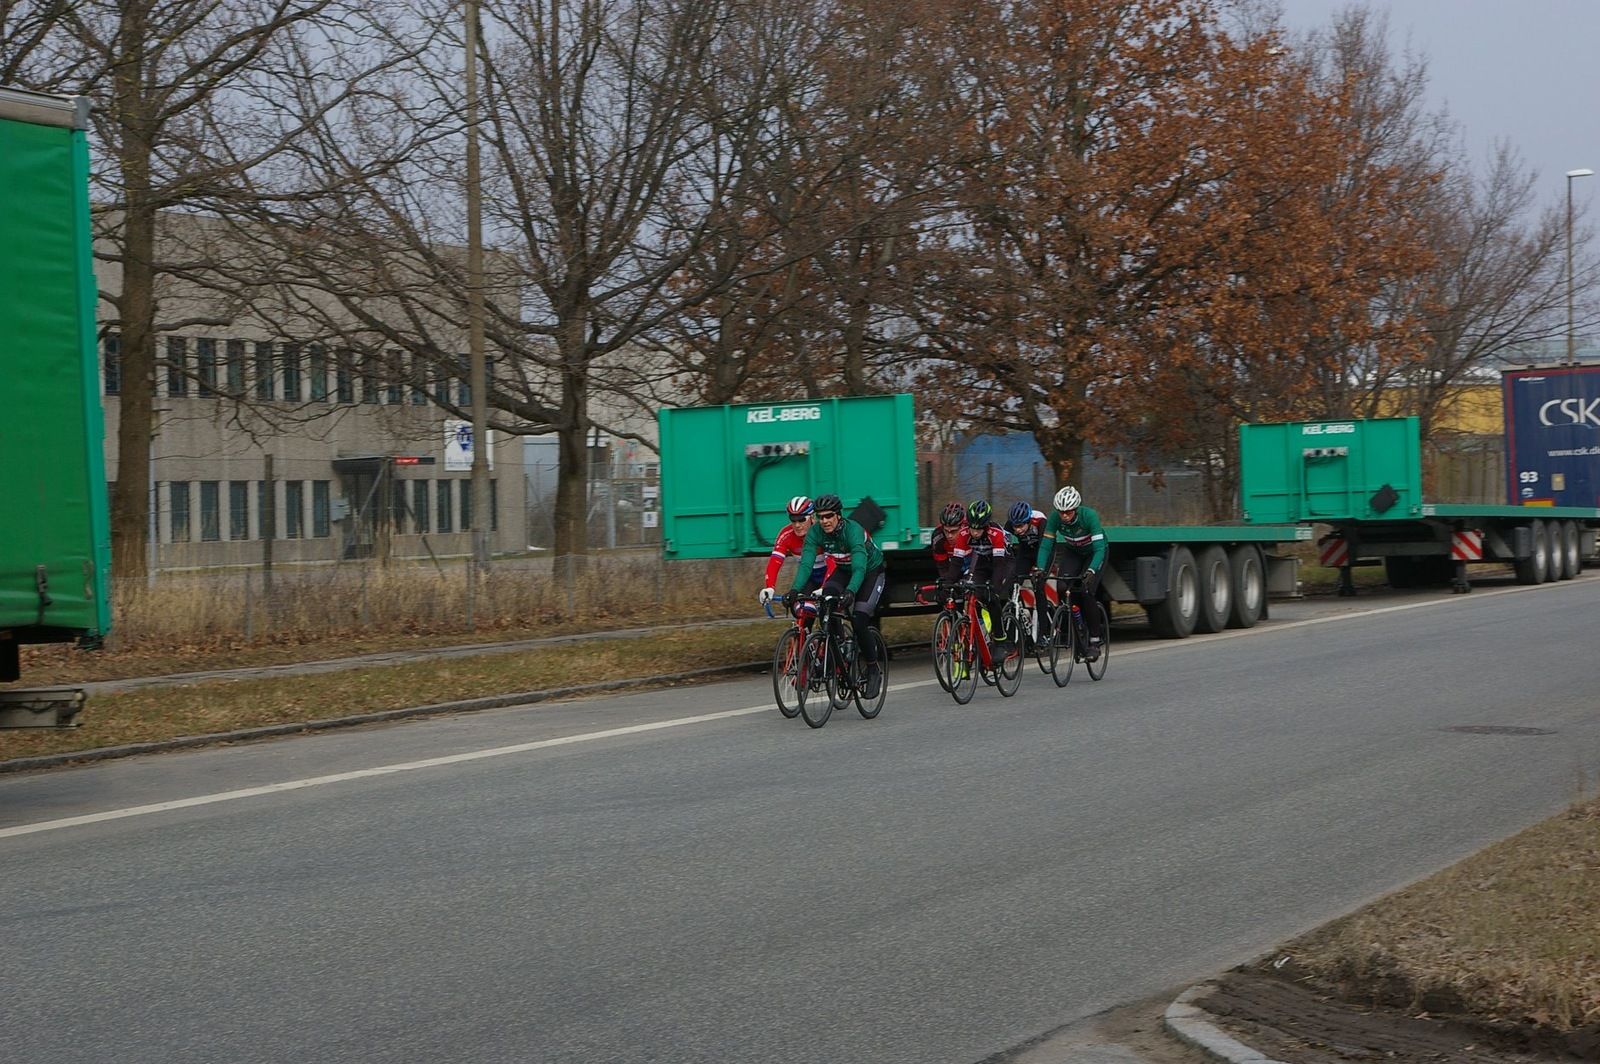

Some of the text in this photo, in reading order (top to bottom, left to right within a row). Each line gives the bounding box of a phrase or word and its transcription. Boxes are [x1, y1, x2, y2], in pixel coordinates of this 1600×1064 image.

[746, 406, 821, 423] KEL-BERG
[1539, 397, 1600, 426] CSK
[1519, 470, 1539, 483] 93
